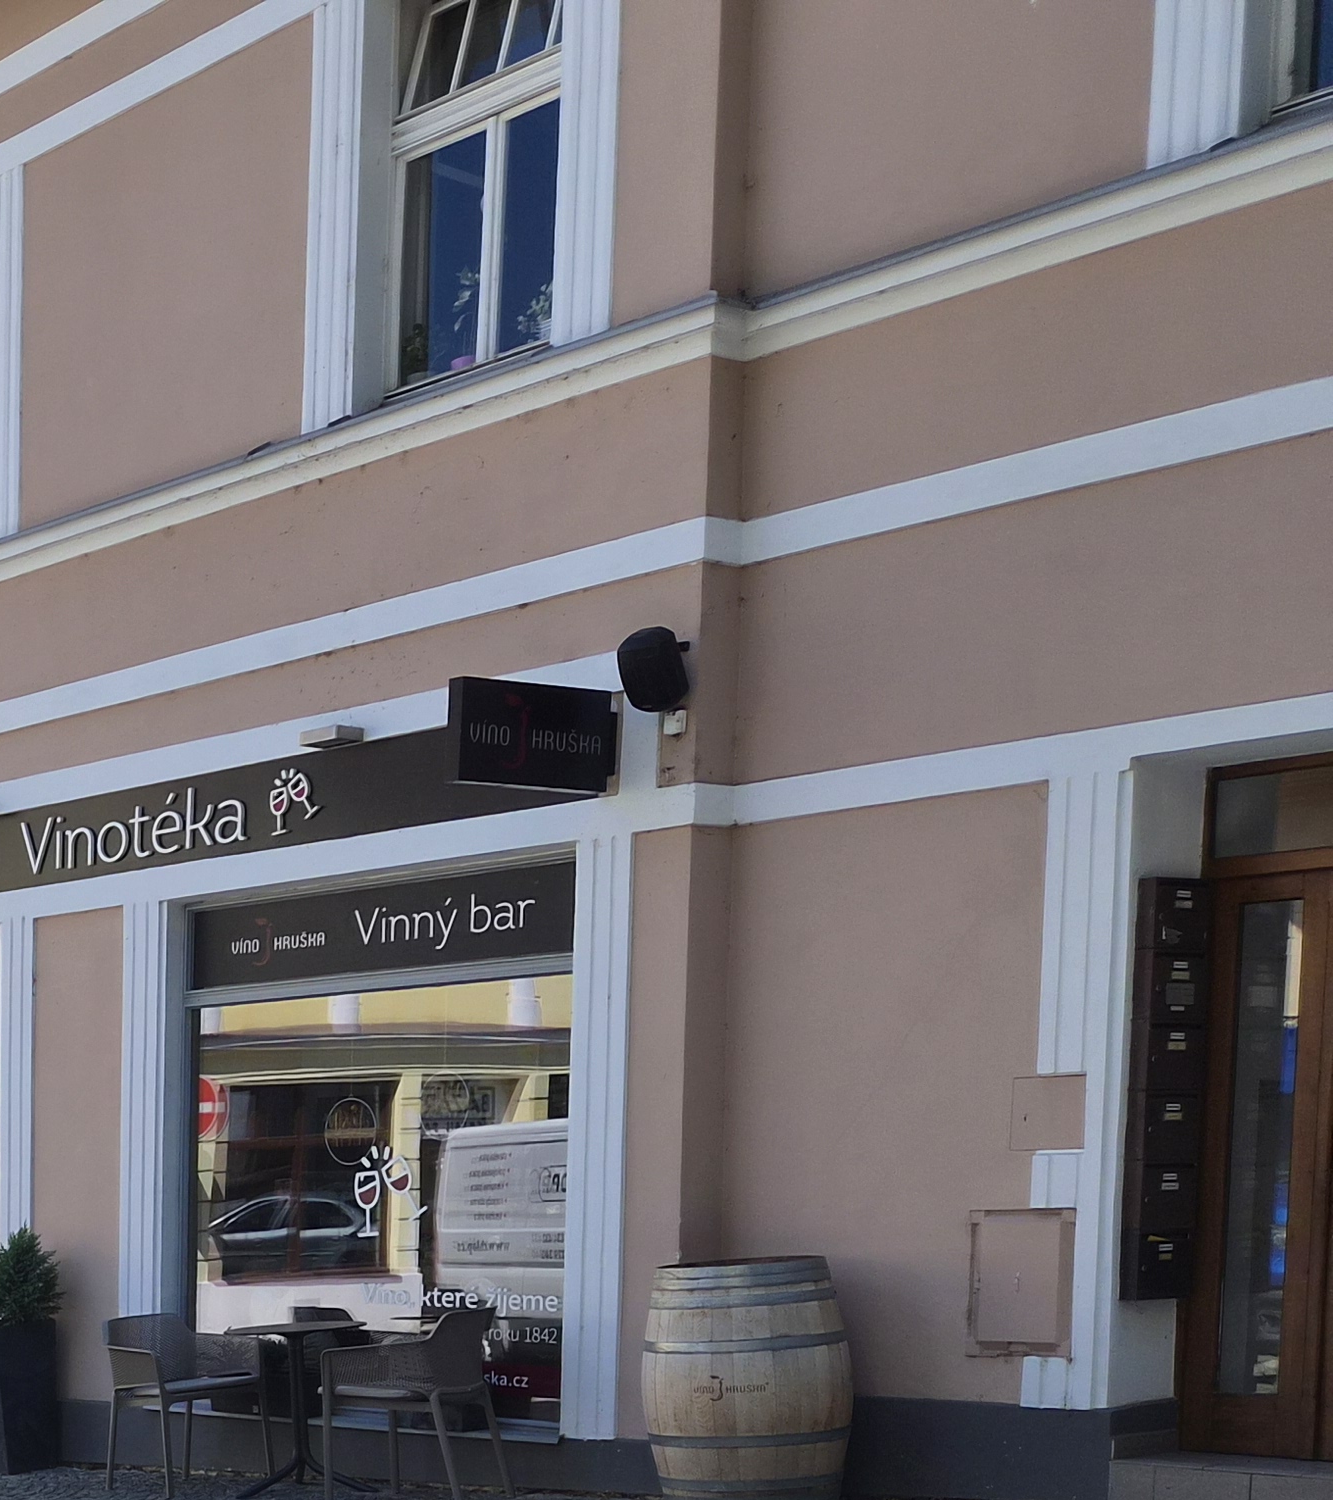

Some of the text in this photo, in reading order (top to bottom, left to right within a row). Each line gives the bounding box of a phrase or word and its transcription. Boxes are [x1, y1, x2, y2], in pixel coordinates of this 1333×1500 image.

[469, 720, 602, 755] VÍNO HRUŠKA
[20, 787, 249, 875] Vinotéka
[354, 893, 536, 950] Vinný bar
[230, 930, 326, 955] VÍNO HRUŠKA
[421, 1284, 478, 1309] které
[485, 1287, 559, 1318] žijeme
[488, 1327, 558, 1344] roku 1842
